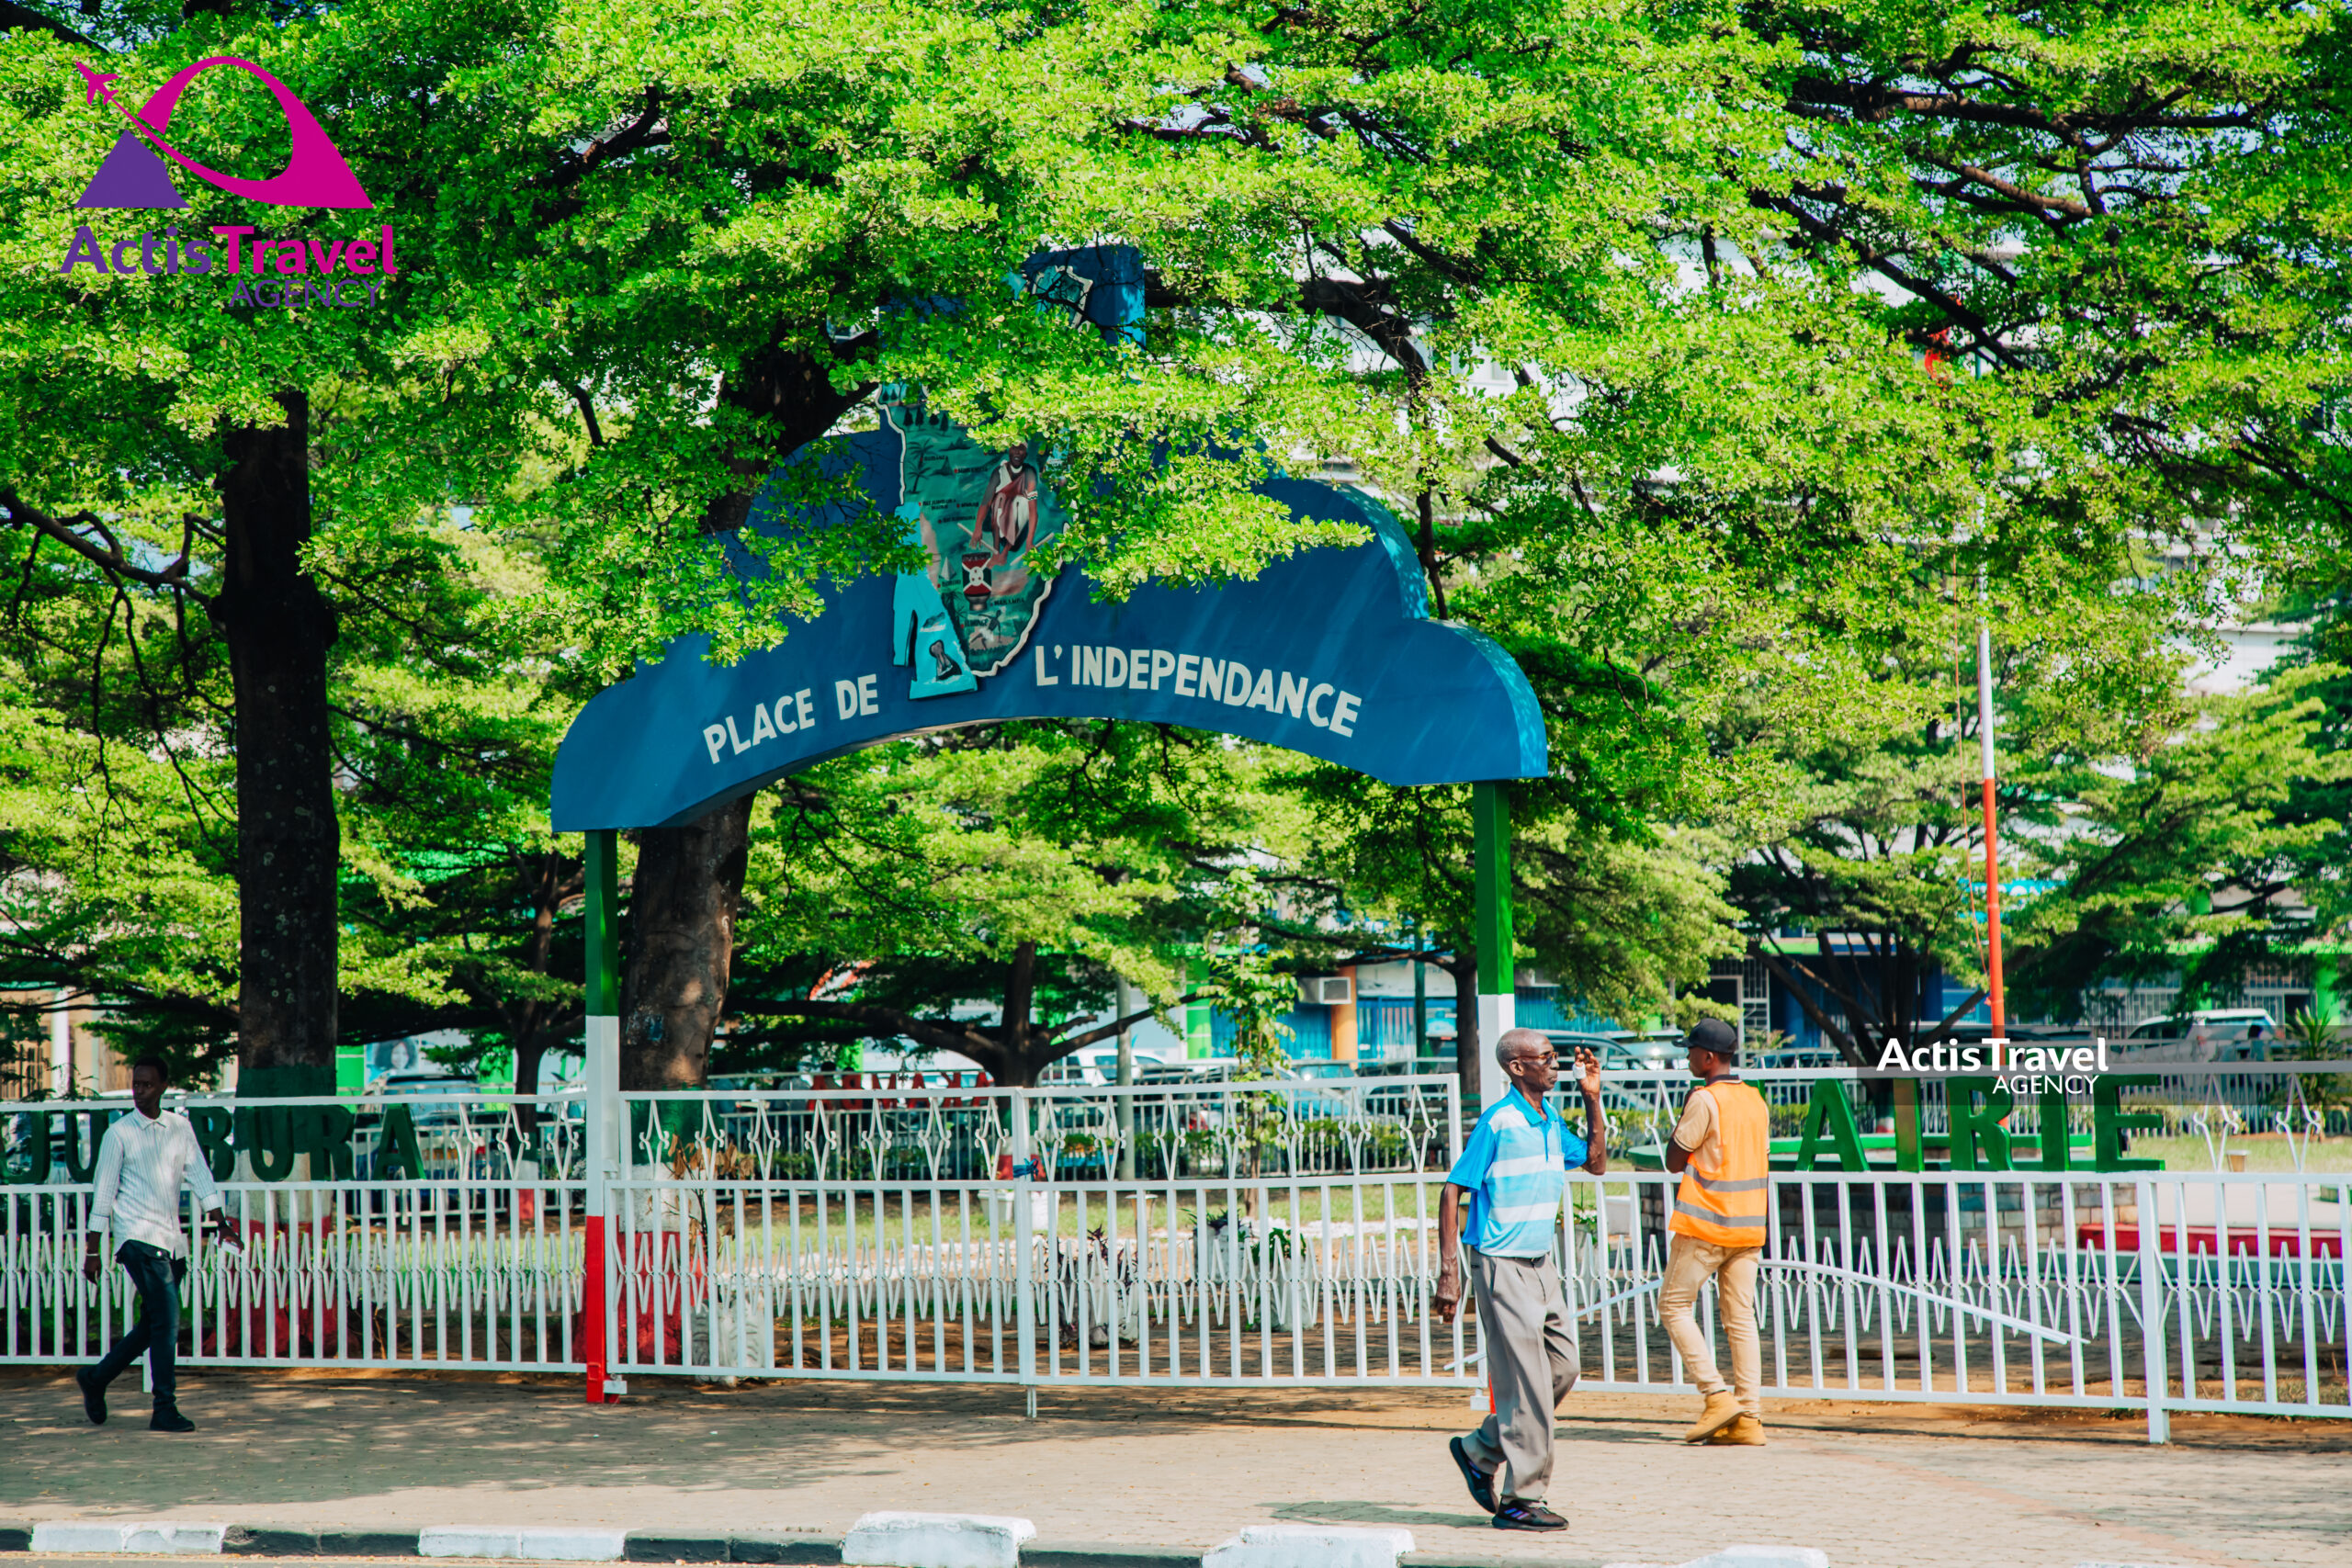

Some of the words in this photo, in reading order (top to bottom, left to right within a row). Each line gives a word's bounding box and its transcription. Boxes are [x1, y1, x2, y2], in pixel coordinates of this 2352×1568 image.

[703, 687, 815, 764] PLACE
[835, 673, 879, 720] DE
[3, 1104, 427, 1184] JUBURA
[1743, 1074, 2165, 1172] AIRIE
